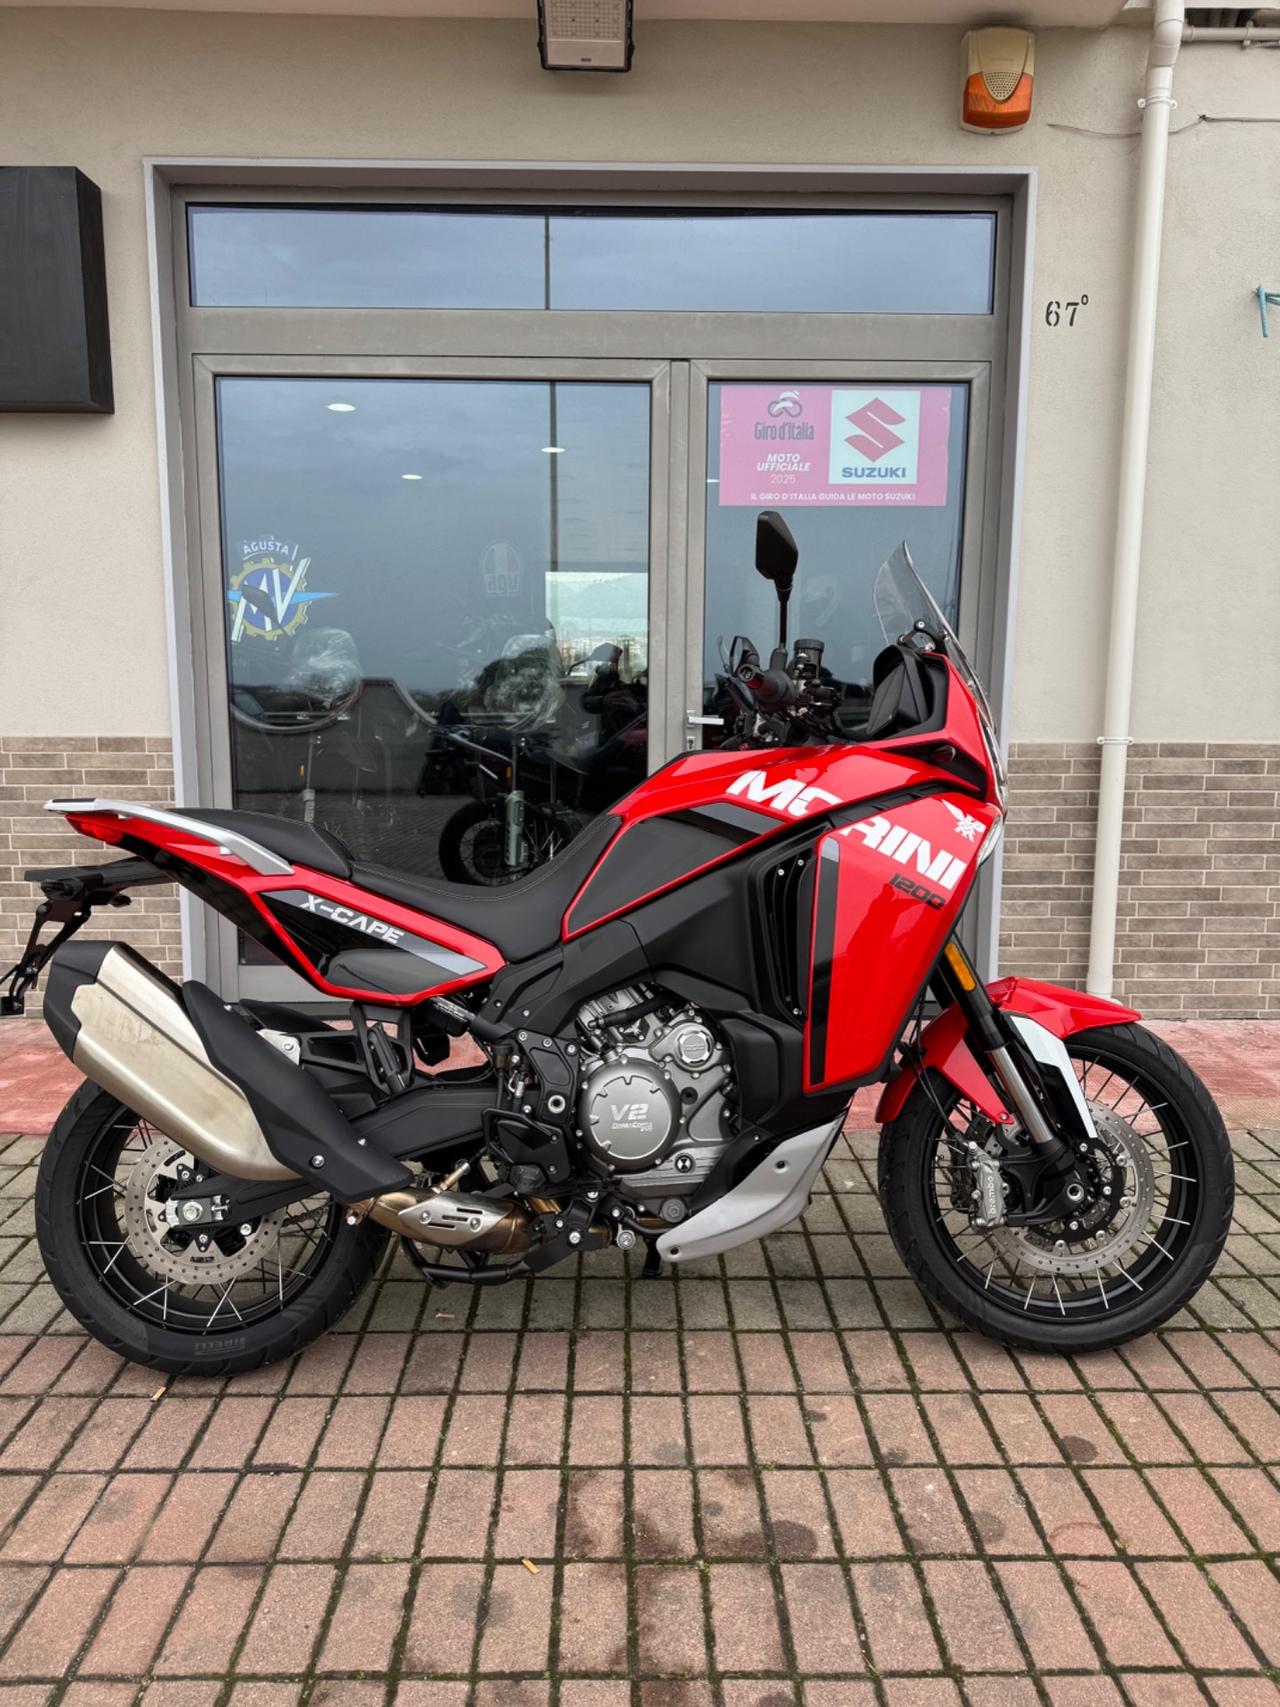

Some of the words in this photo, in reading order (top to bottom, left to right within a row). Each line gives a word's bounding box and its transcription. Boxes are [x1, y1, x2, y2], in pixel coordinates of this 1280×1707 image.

[755, 422, 778, 441] Giro
[780, 421, 815, 441] d'Italia
[767, 453, 801, 463] MOTO
[756, 462, 812, 472] UFFICIALE
[841, 467, 907, 478] SUZUKI
[770, 474, 796, 484] 2025
[751, 492, 759, 500] IL
[759, 492, 780, 500] GIRO
[818, 492, 846, 500] GUIDA
[846, 492, 857, 500] LE
[857, 492, 883, 500] MOTO
[884, 492, 916, 500] SUZUKI
[243, 540, 289, 555] AGUSTA
[889, 872, 947, 910] 1200
[299, 894, 405, 945] X-CAPE
[610, 1103, 649, 1121] V2
[986, 1175, 998, 1215] brembo
